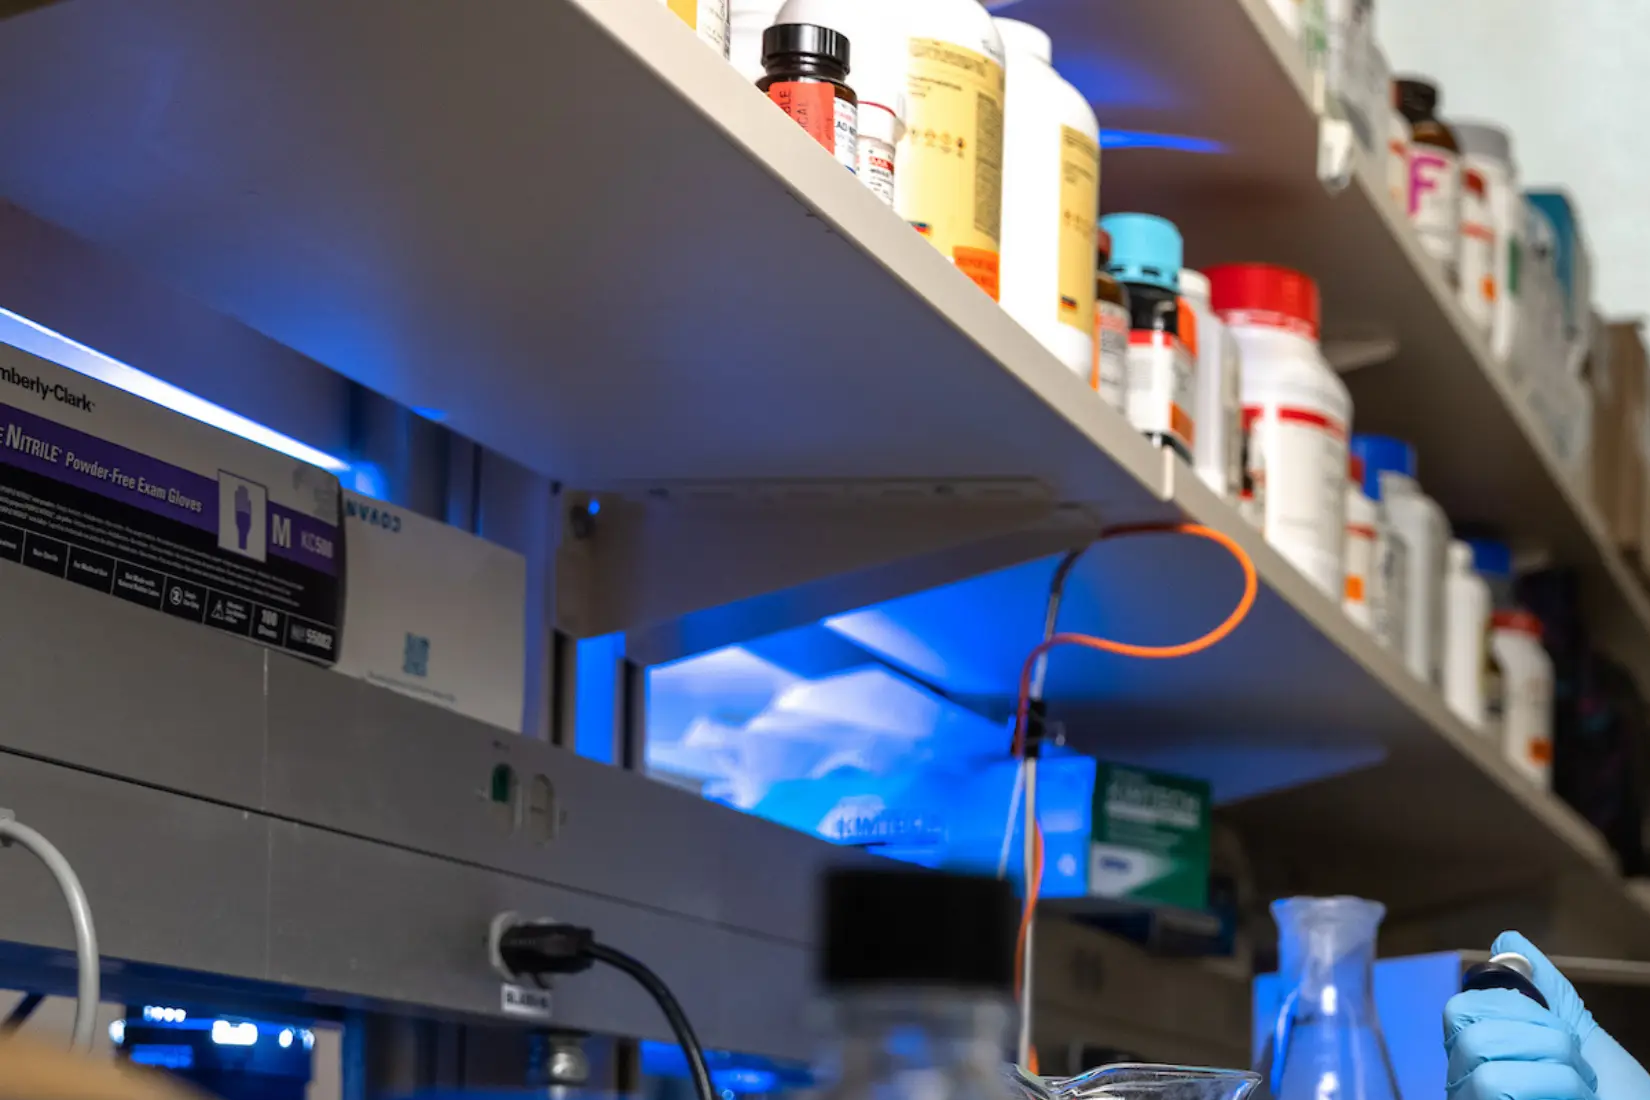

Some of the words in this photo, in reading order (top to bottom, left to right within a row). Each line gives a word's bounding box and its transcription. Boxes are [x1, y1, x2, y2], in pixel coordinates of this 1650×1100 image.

[1408, 155, 1447, 217] F
[65, 451, 136, 489] Powder-Free
[137, 476, 166, 501] Exam
[167, 487, 203, 514] Gloves
[271, 513, 292, 549] M
